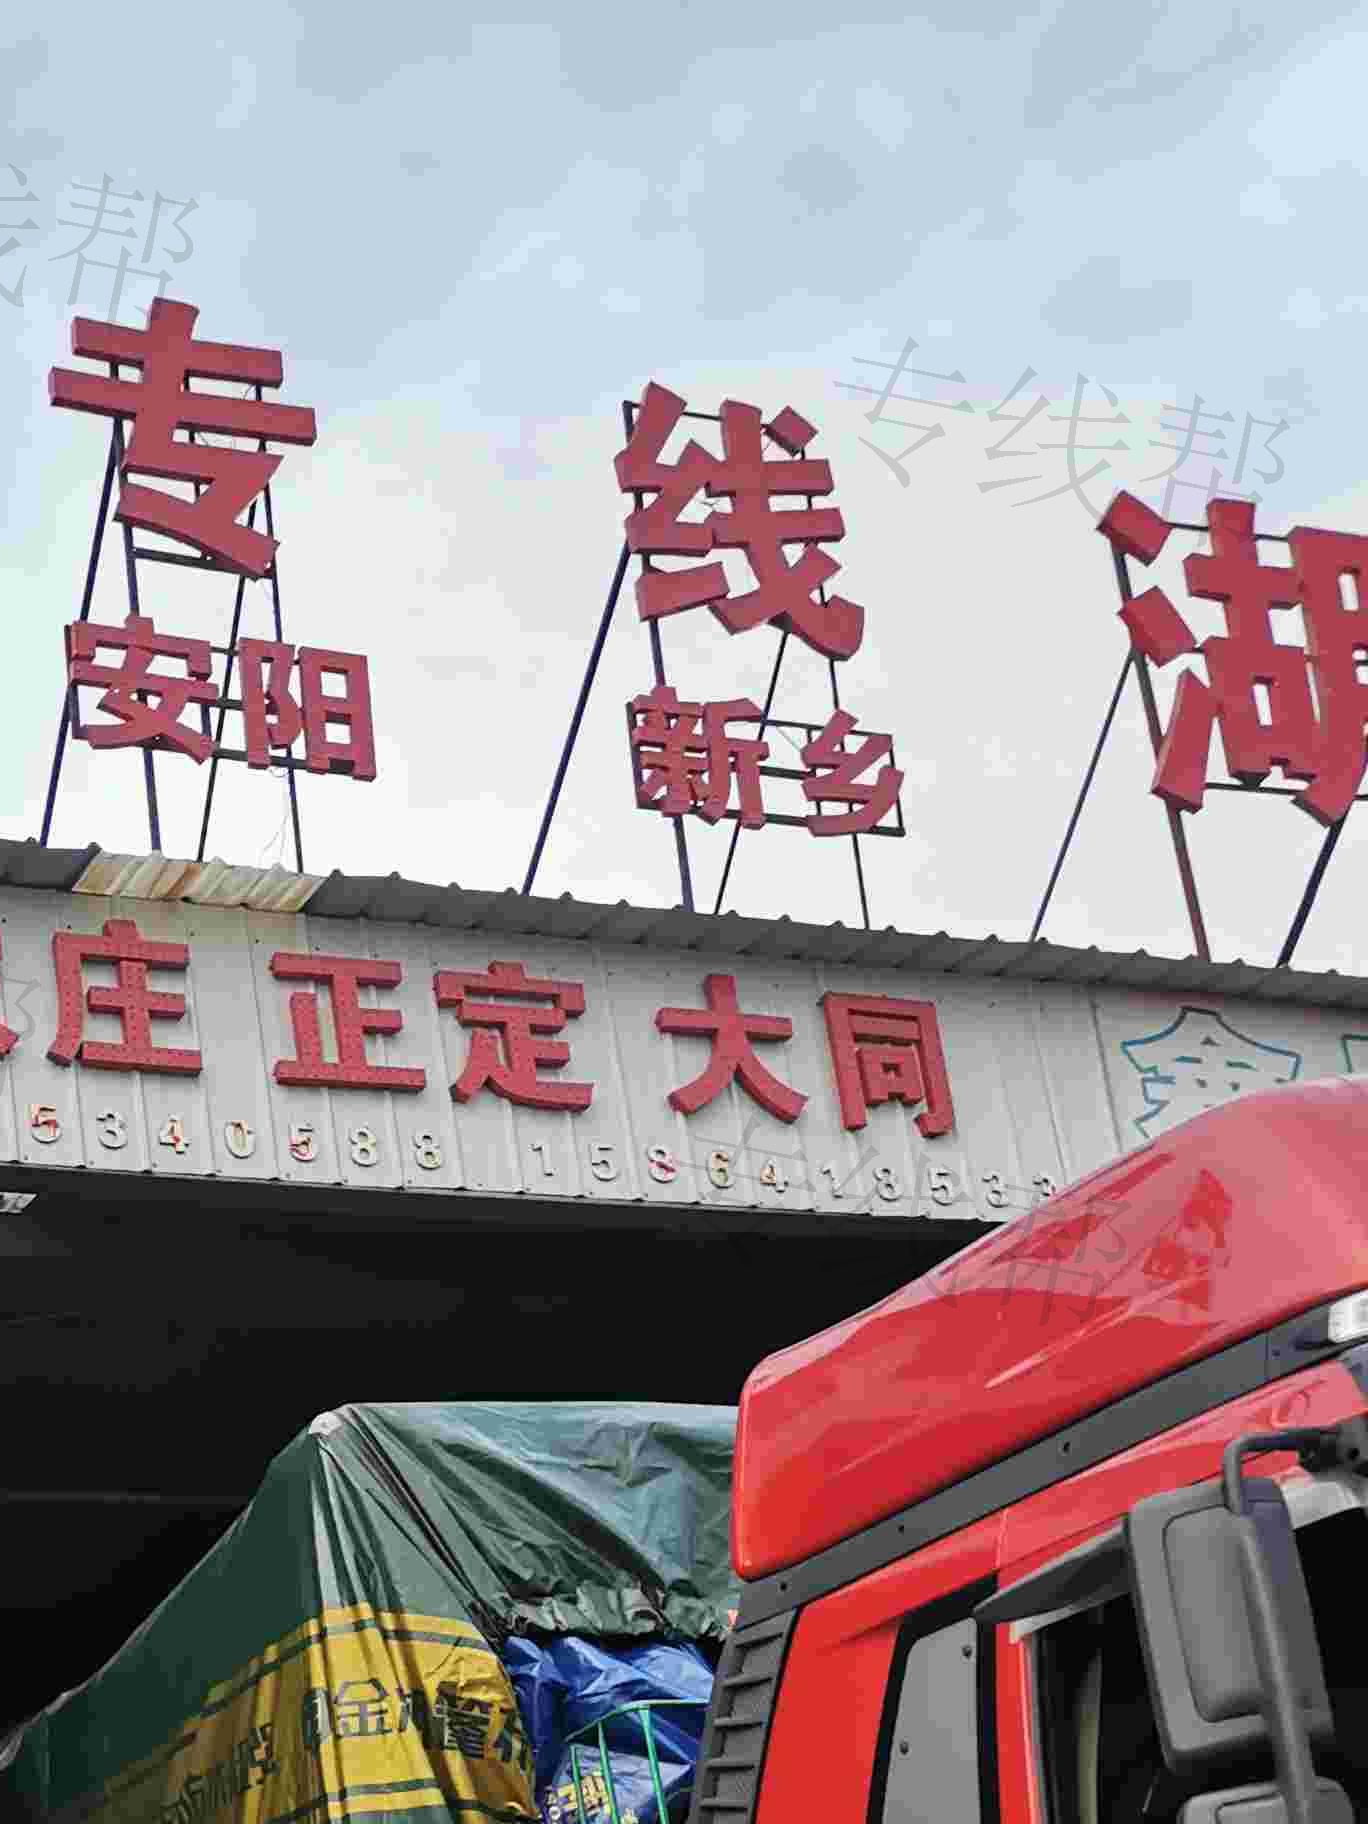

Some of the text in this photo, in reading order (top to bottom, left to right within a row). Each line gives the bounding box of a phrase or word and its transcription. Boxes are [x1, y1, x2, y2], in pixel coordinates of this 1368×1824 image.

[65, 614, 376, 783] 安阳
[630, 684, 904, 836] 新乡
[270, 951, 595, 1113] 正定
[654, 974, 956, 1138] 大同
